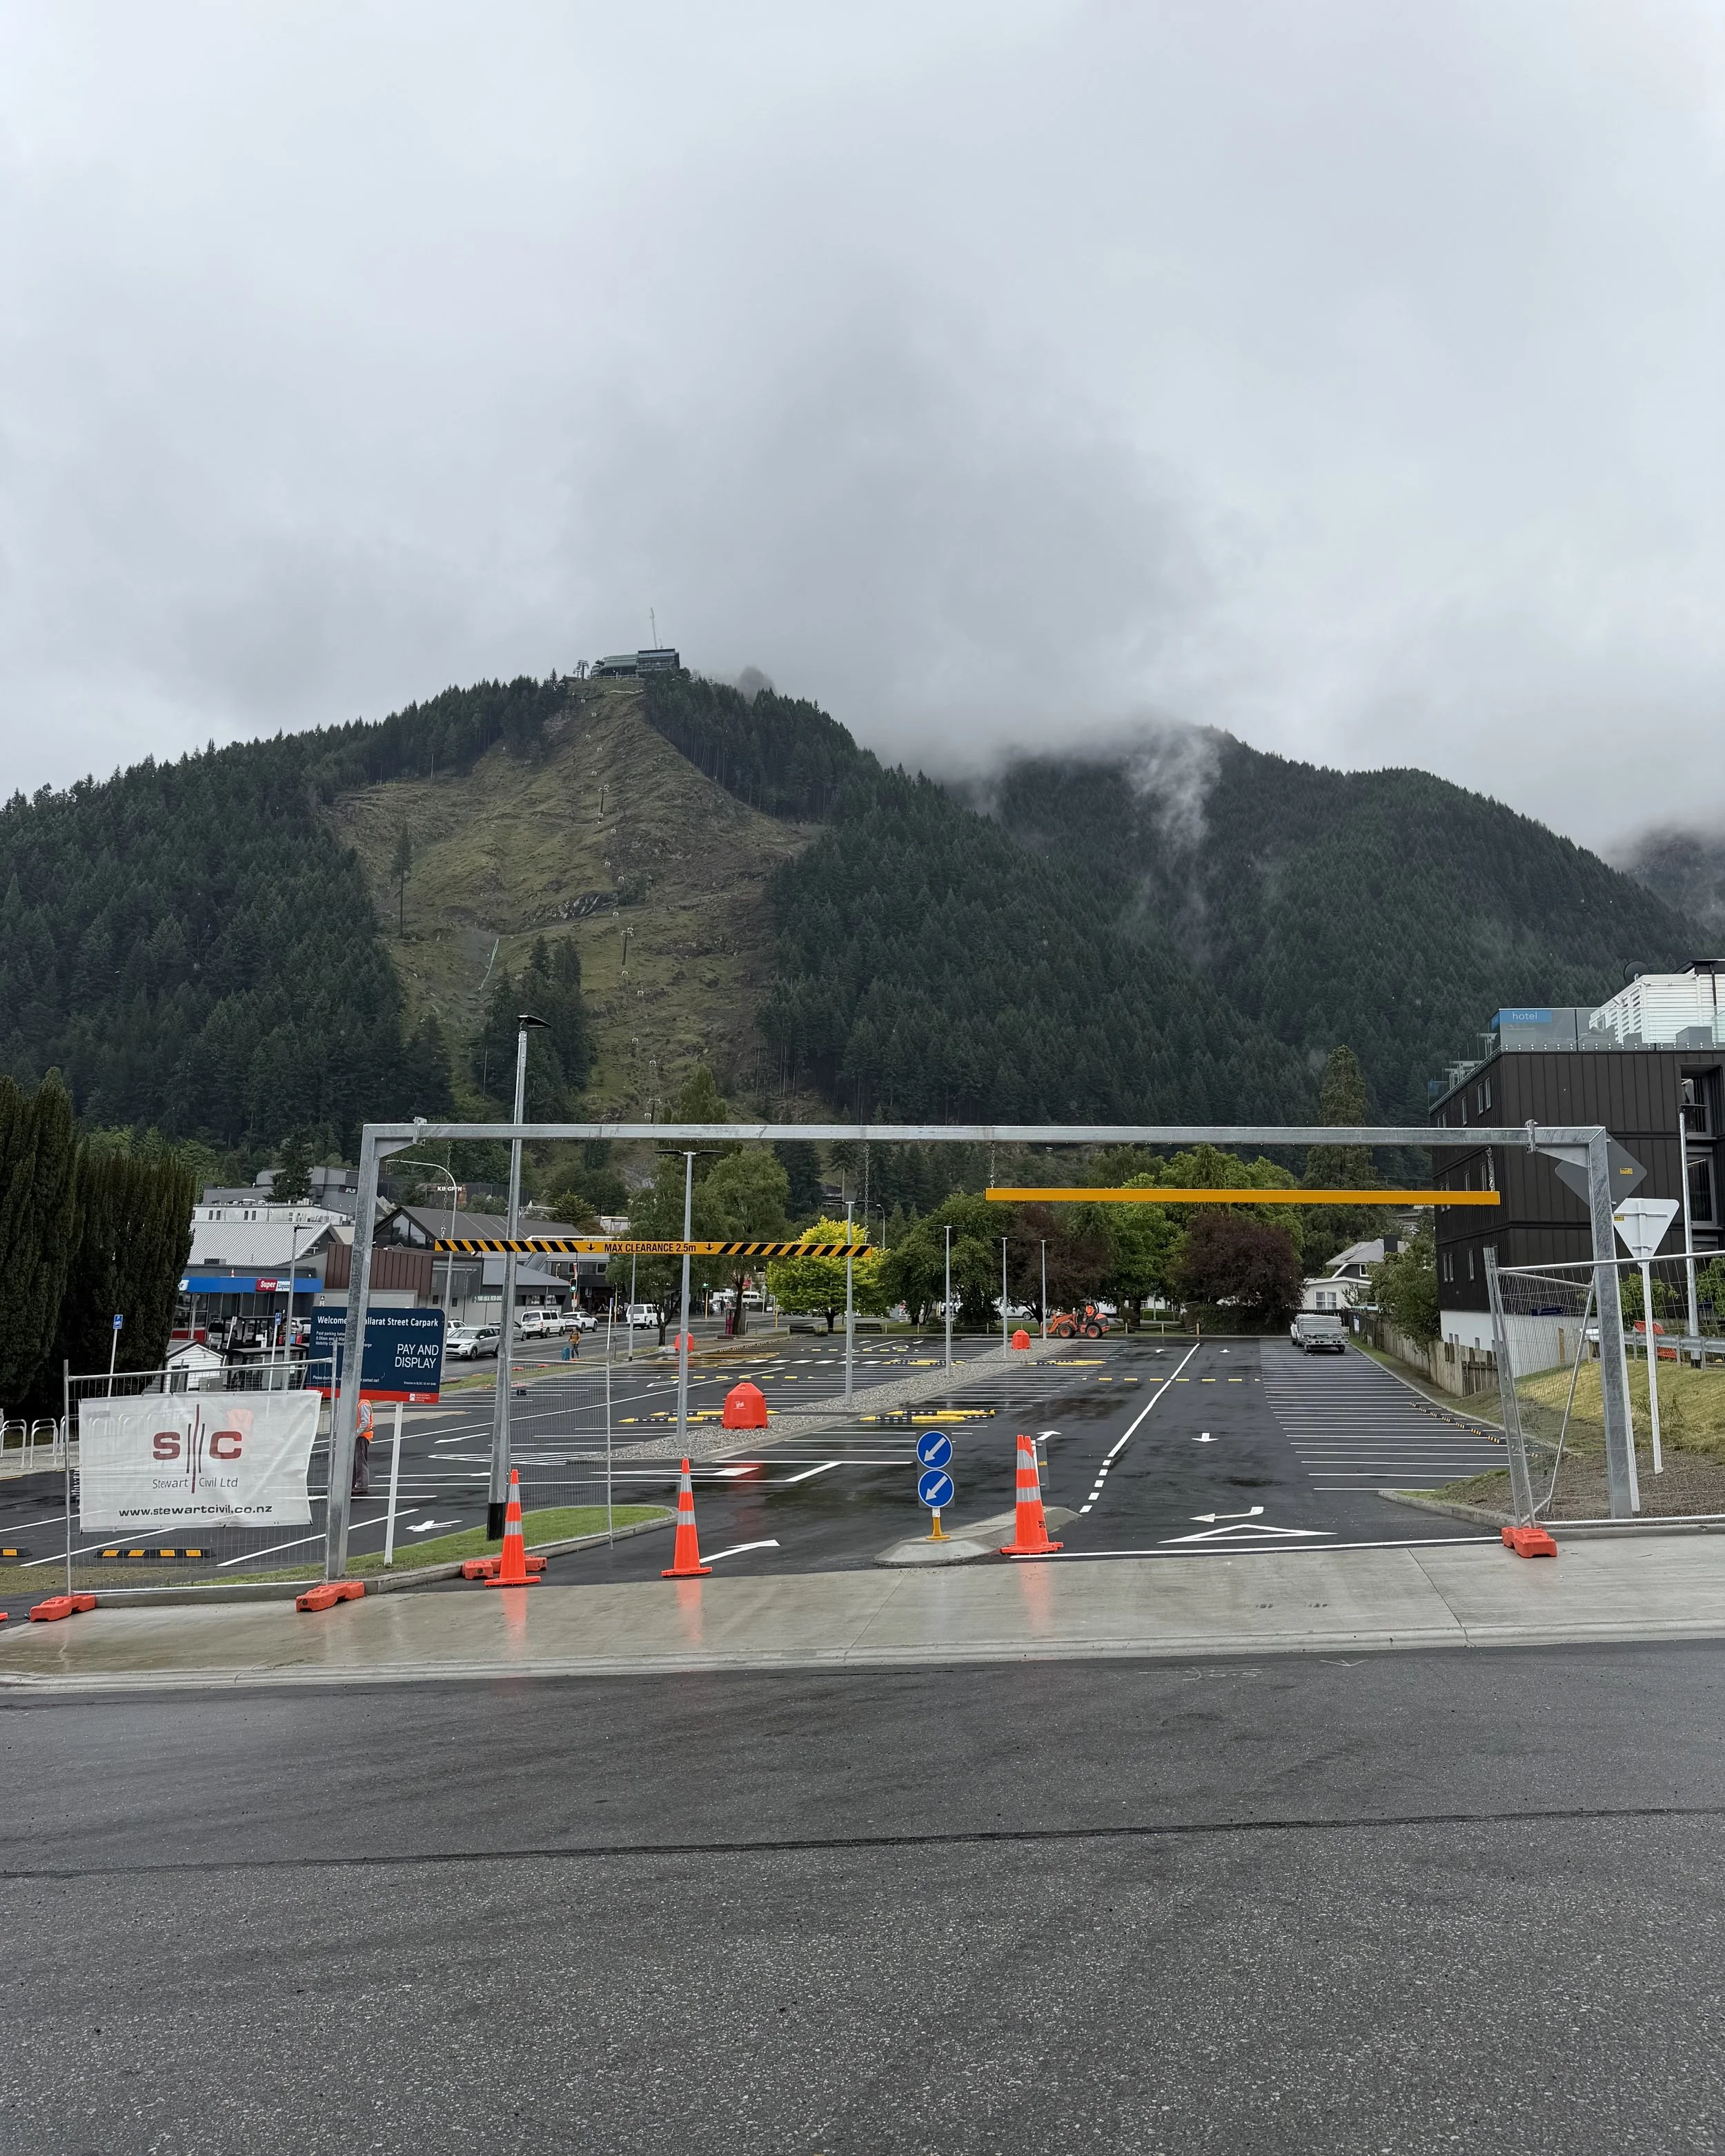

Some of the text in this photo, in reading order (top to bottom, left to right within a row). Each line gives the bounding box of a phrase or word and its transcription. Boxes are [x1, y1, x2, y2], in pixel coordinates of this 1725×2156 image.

[1512, 1011, 1537, 1020] hotel
[604, 1243, 696, 1252] MAX CLEARANCE 2.5m
[260, 1280, 276, 1289] Super
[317, 1316, 438, 1328] Welcome allarat Street Carpark
[397, 1344, 439, 1356] PAY AND
[395, 1356, 436, 1369] DISPLAY
[152, 1431, 242, 1461] S C
[152, 1477, 238, 1489] Stewart Civil Ltd
[119, 1504, 273, 1517] www.stewartcivil.co.nz
